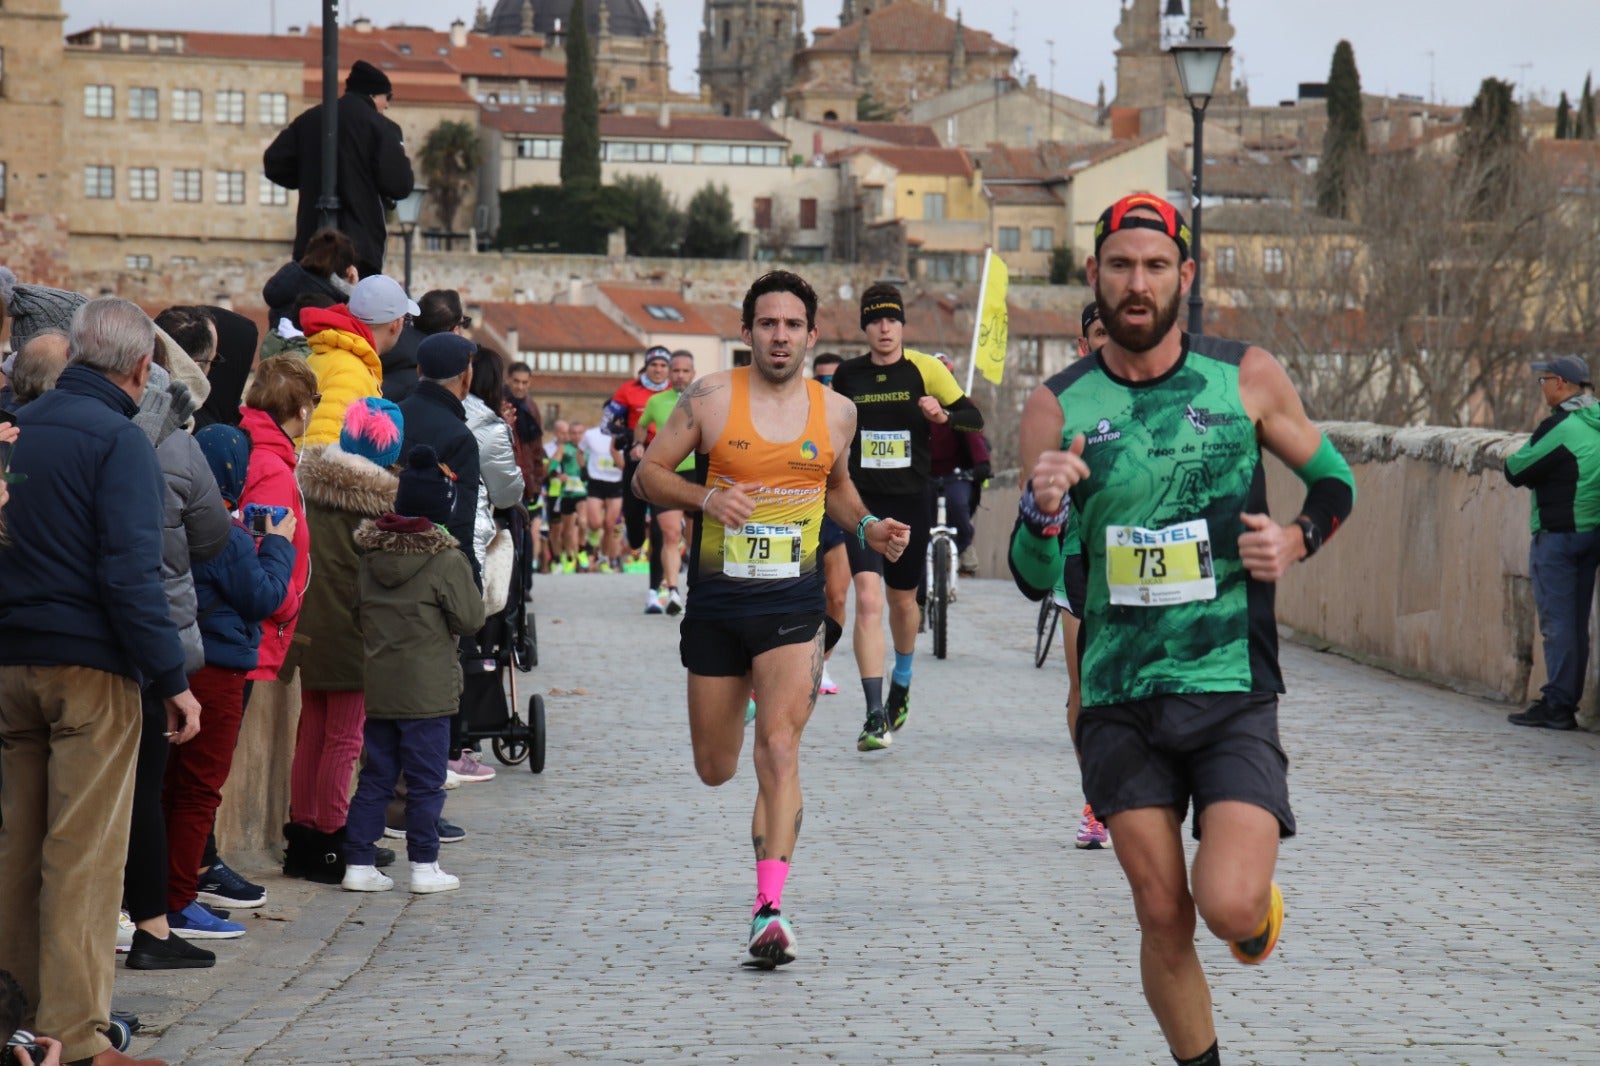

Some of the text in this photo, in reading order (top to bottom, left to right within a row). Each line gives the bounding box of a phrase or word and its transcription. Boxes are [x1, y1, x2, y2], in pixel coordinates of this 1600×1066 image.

[1087, 431, 1121, 445] VIATOR
[871, 441, 895, 456] 204
[1181, 443, 1196, 454] de
[744, 525, 794, 535] SETEL
[1132, 527, 1198, 545] SETEL
[747, 537, 770, 560] 79
[1134, 548, 1167, 578] 73
